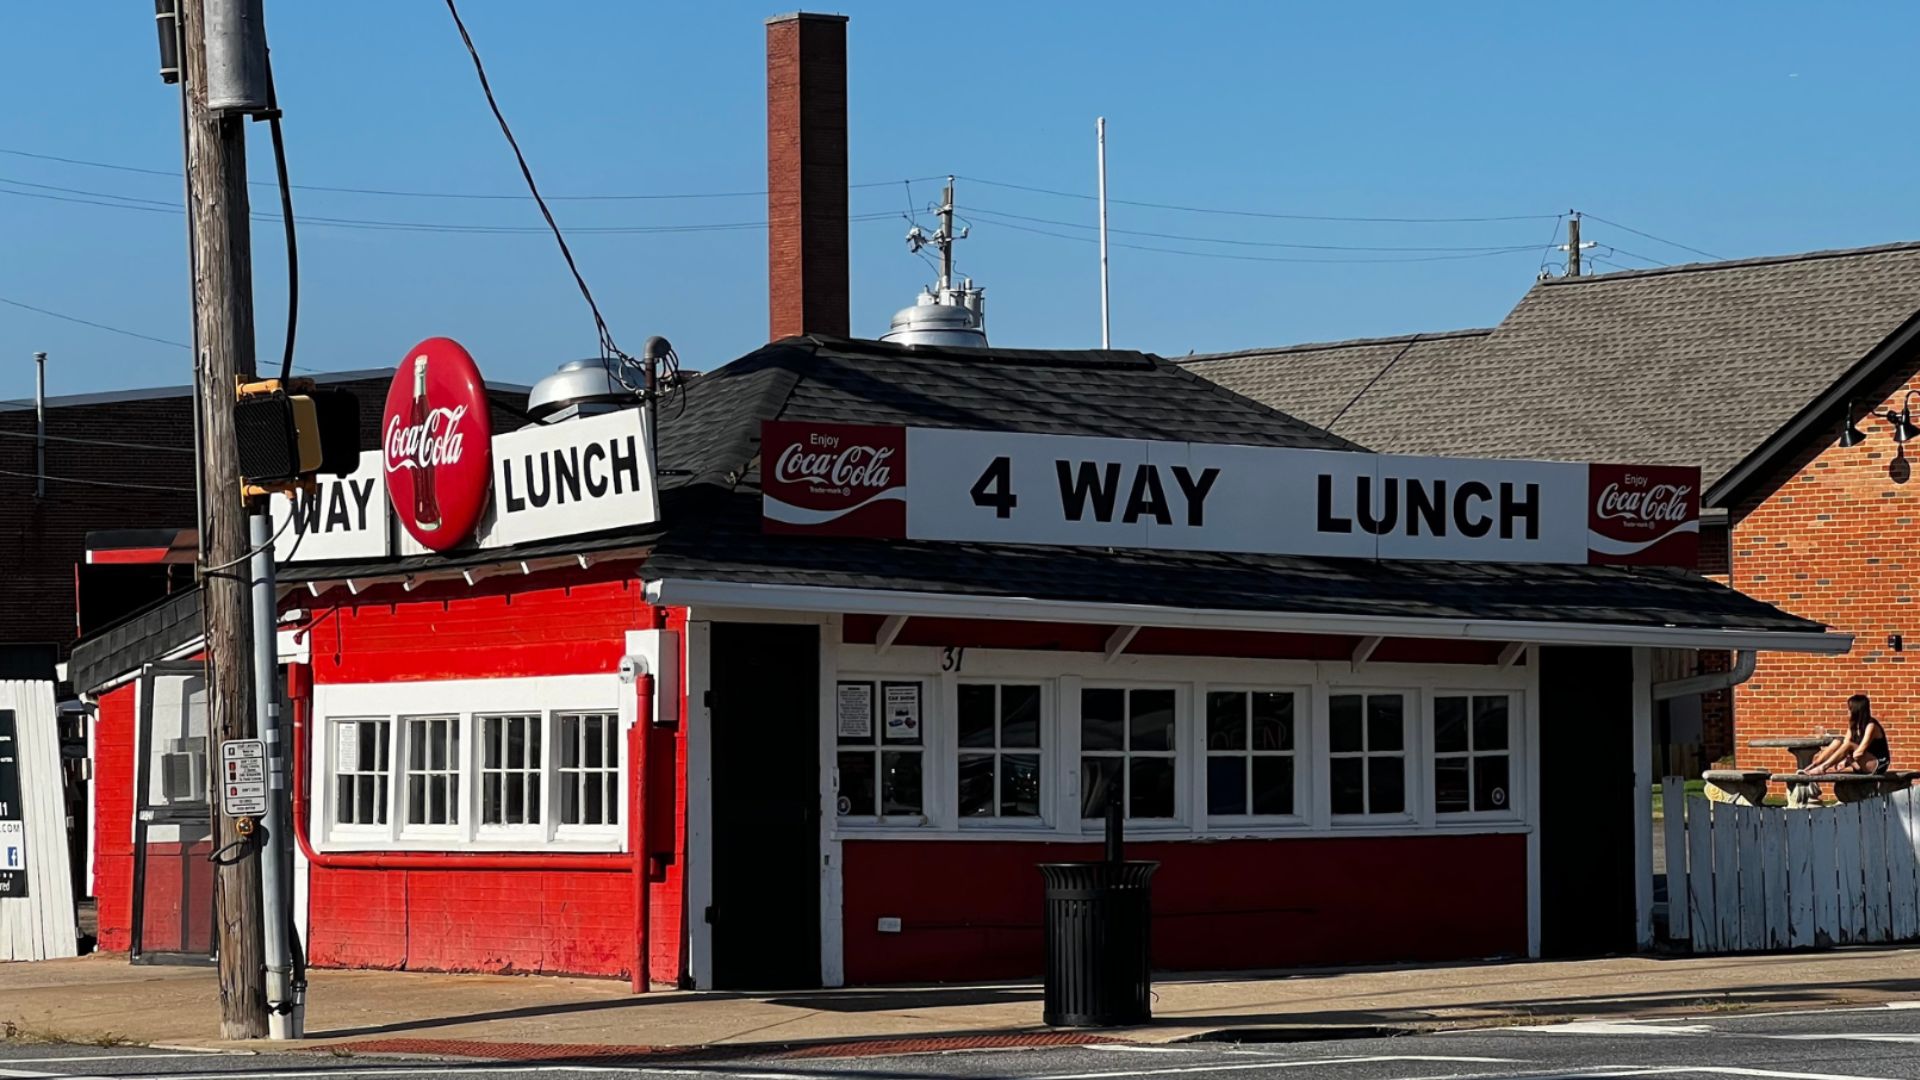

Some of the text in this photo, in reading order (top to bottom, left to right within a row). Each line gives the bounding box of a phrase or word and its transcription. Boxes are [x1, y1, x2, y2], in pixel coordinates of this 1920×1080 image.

[385, 403, 467, 473] Coca-Cola
[810, 433, 840, 448] Enjoy
[503, 435, 640, 513] LUNCH
[775, 442, 895, 488] Coca-Cola
[1624, 474, 1648, 487] Enjoy
[292, 478, 376, 535] WAY
[969, 456, 1540, 540] 4 WAY LUNCH
[1597, 482, 1692, 521] Coca-Cola
[942, 646, 964, 672] 31
